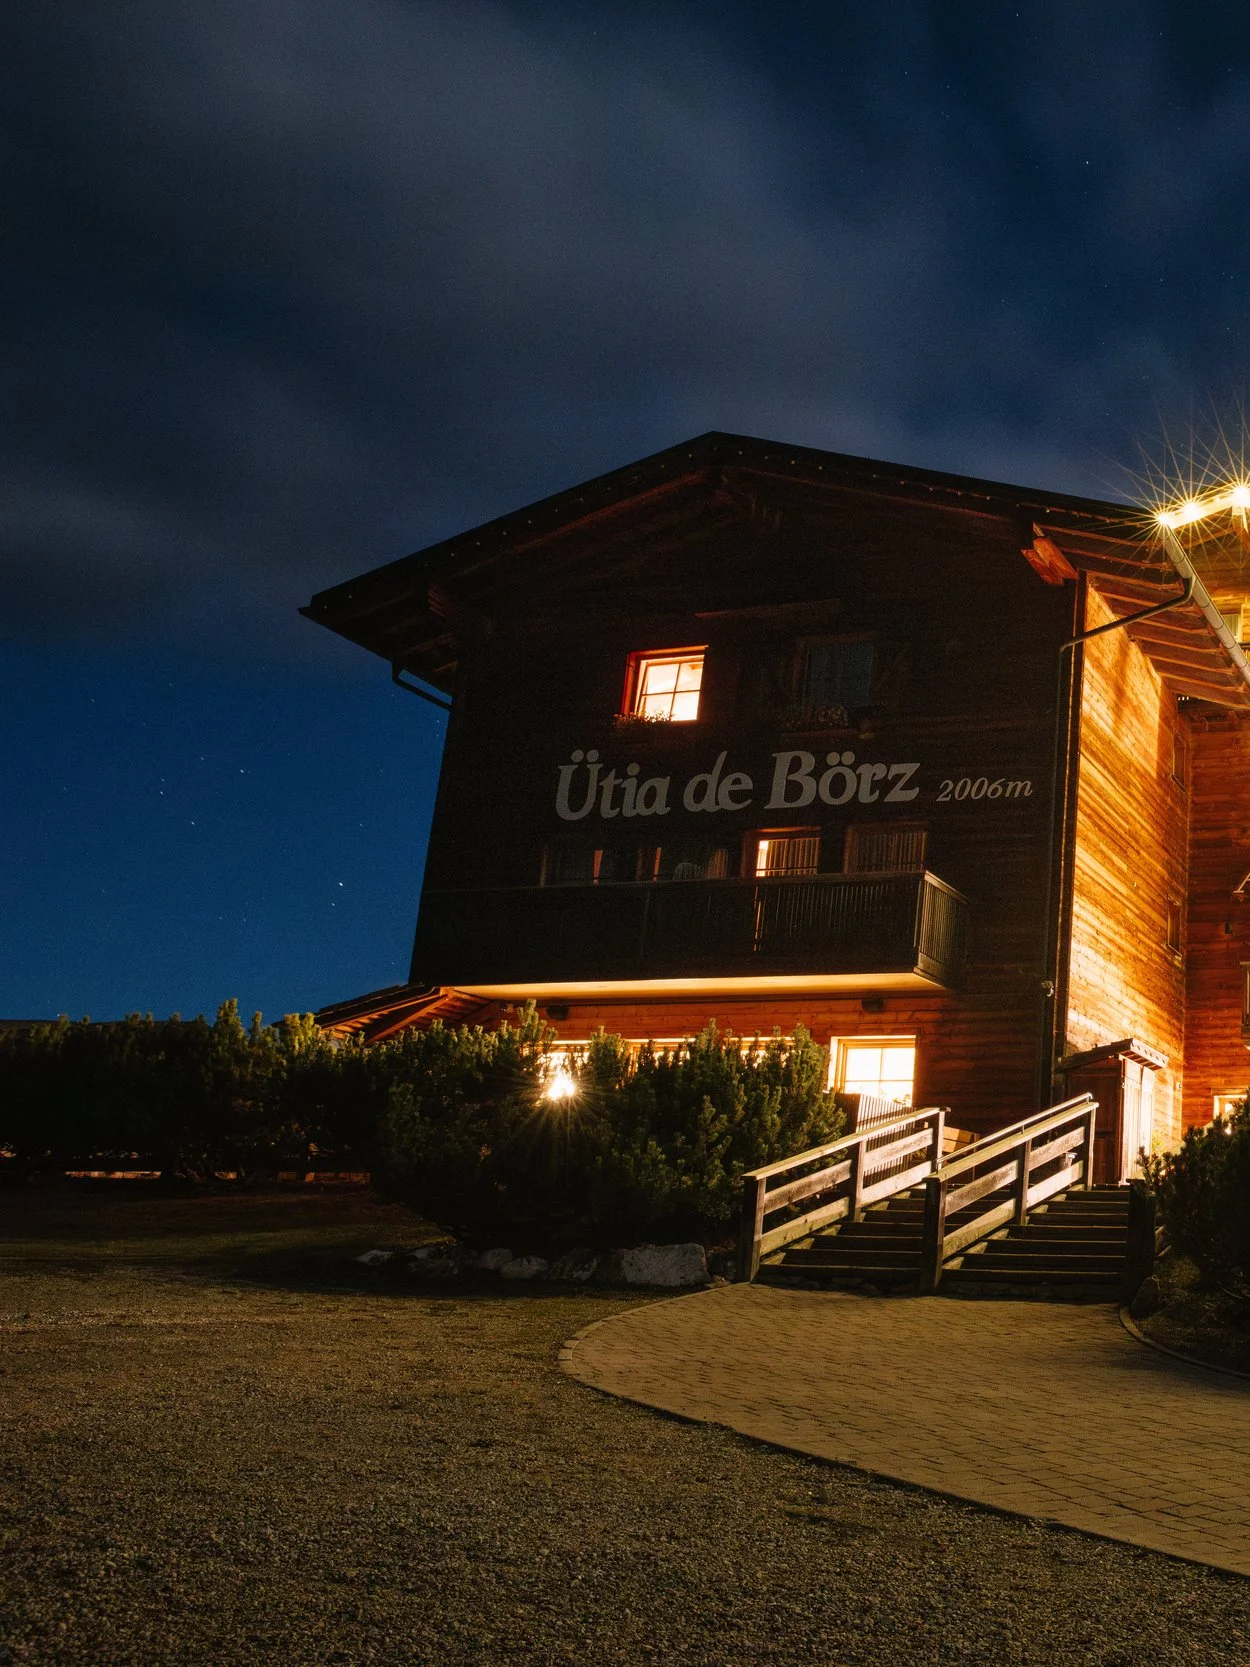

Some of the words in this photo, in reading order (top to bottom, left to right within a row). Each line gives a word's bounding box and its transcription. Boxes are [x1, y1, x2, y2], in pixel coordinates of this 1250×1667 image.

[555, 749, 670, 821] Ütia
[683, 751, 753, 813] de
[764, 750, 920, 810] Börz
[936, 777, 1033, 802] 2006m
